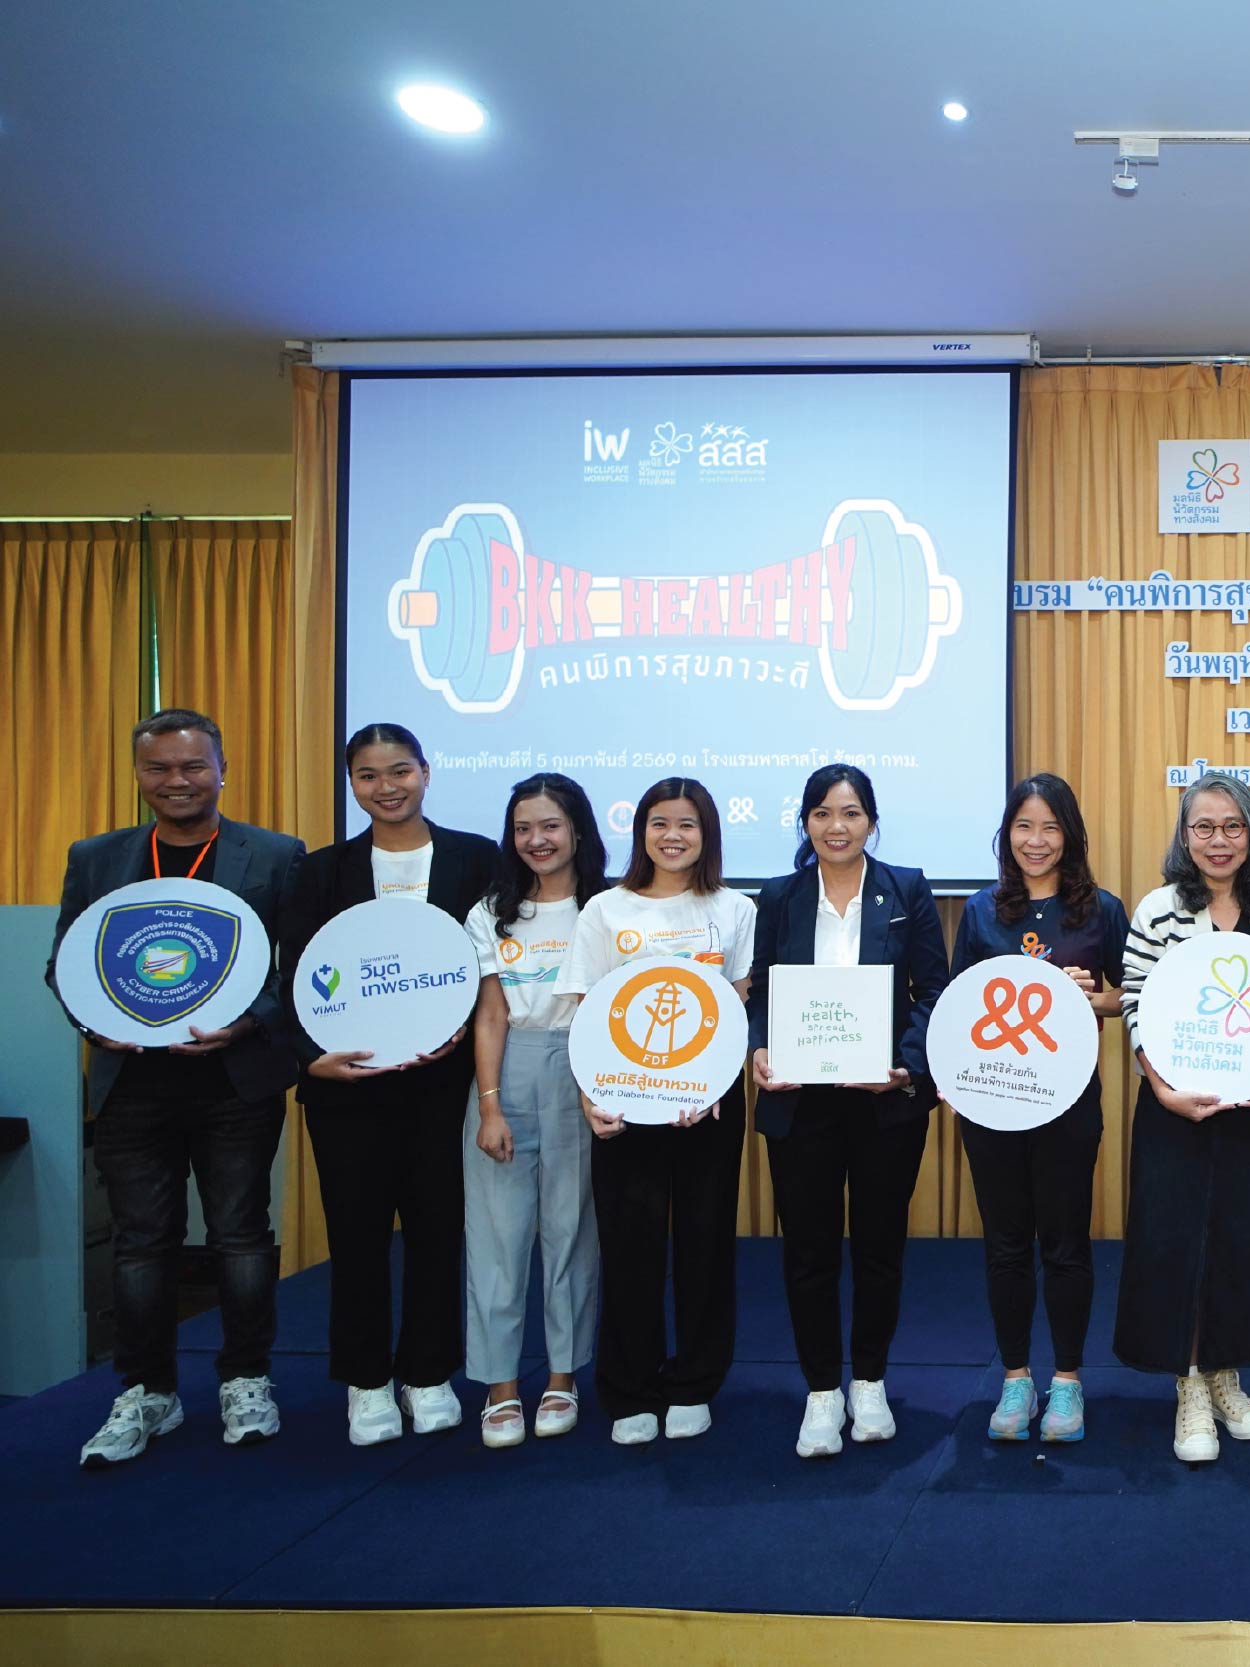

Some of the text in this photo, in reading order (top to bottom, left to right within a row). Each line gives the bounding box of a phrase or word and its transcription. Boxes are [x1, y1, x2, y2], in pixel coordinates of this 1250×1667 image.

[932, 343, 972, 351] VERTEX
[699, 439, 769, 467] สสส
[584, 465, 629, 474] INCLUSIVE
[489, 534, 857, 656] BKK HEALTHY
[1014, 583, 1071, 607] บรม
[540, 653, 811, 689] คนพิการสุขภาวะดี
[537, 754, 547, 769] 5
[632, 753, 676, 768] 2569
[882, 755, 920, 768] กทม.
[1169, 769, 1188, 784] ณ
[154, 909, 194, 918] POLICE
[361, 962, 401, 981] วิมุต
[116, 976, 209, 1005] INVESTIGATION BUREAU
[129, 978, 196, 997] CYBER CRIME
[361, 966, 468, 997] เทพธารินทร์
[809, 1000, 843, 1009] Share
[801, 1009, 858, 1023] Health,
[1173, 1019, 1220, 1039] มูลนิธิ
[1172, 1036, 1244, 1057] นวัตกรรม
[642, 1053, 670, 1066] FDF
[1171, 1053, 1243, 1073] ทางสังคม
[978, 1061, 1038, 1080] มูลนิธิด้วยกัน
[595, 1071, 707, 1092] มูลนิธิสู้เบาหวาน
[956, 1067, 1056, 1097] เพื่อคนพิการและสังคม
[592, 1087, 705, 1105] Fight Diabetes Foundation
